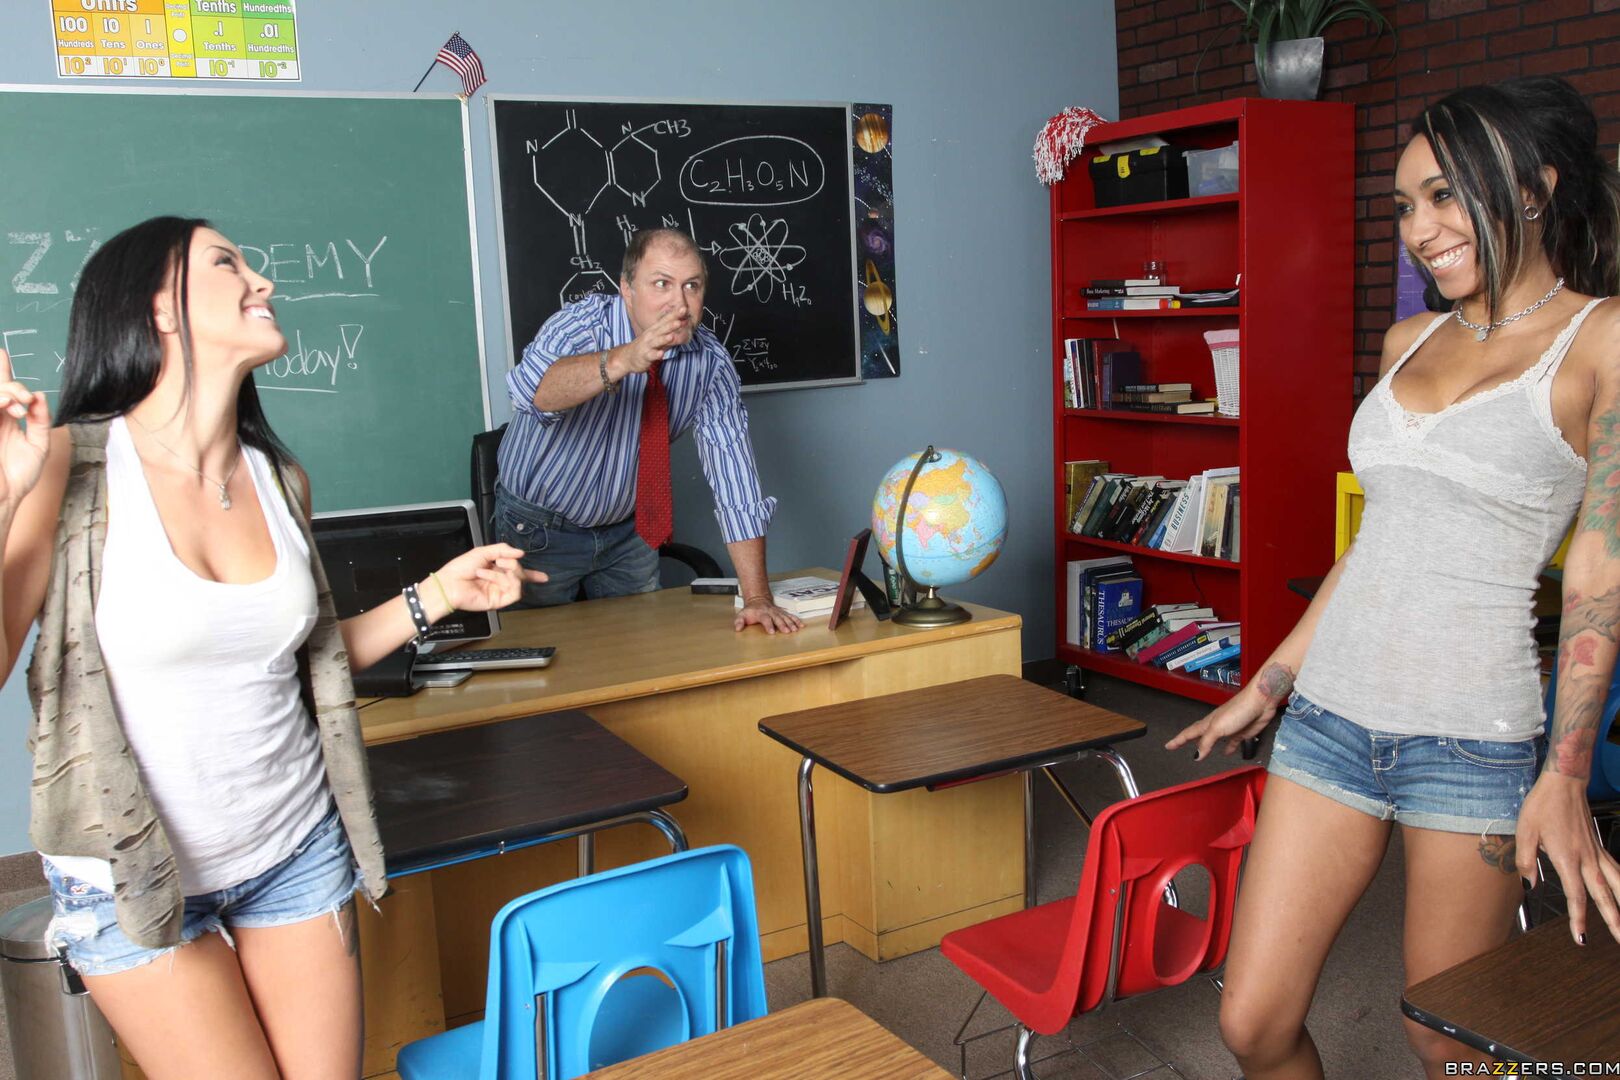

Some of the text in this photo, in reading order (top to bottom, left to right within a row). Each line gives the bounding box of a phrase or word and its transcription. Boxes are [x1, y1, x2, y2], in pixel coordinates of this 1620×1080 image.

[196, 0, 236, 13] Tenths
[243, 2, 292, 13] Hundredths
[60, 16, 88, 33] 100
[103, 17, 120, 33] 10
[260, 24, 279, 38] .01
[58, 39, 94, 48] Hundreds
[101, 39, 126, 49] Tens
[136, 40, 164, 49] Ones
[203, 42, 236, 51] Tenths
[248, 44, 295, 53] Hundredths
[526, 139, 538, 154] N
[632, 191, 646, 208] N
[1097, 590, 1106, 645] THESAURUS
